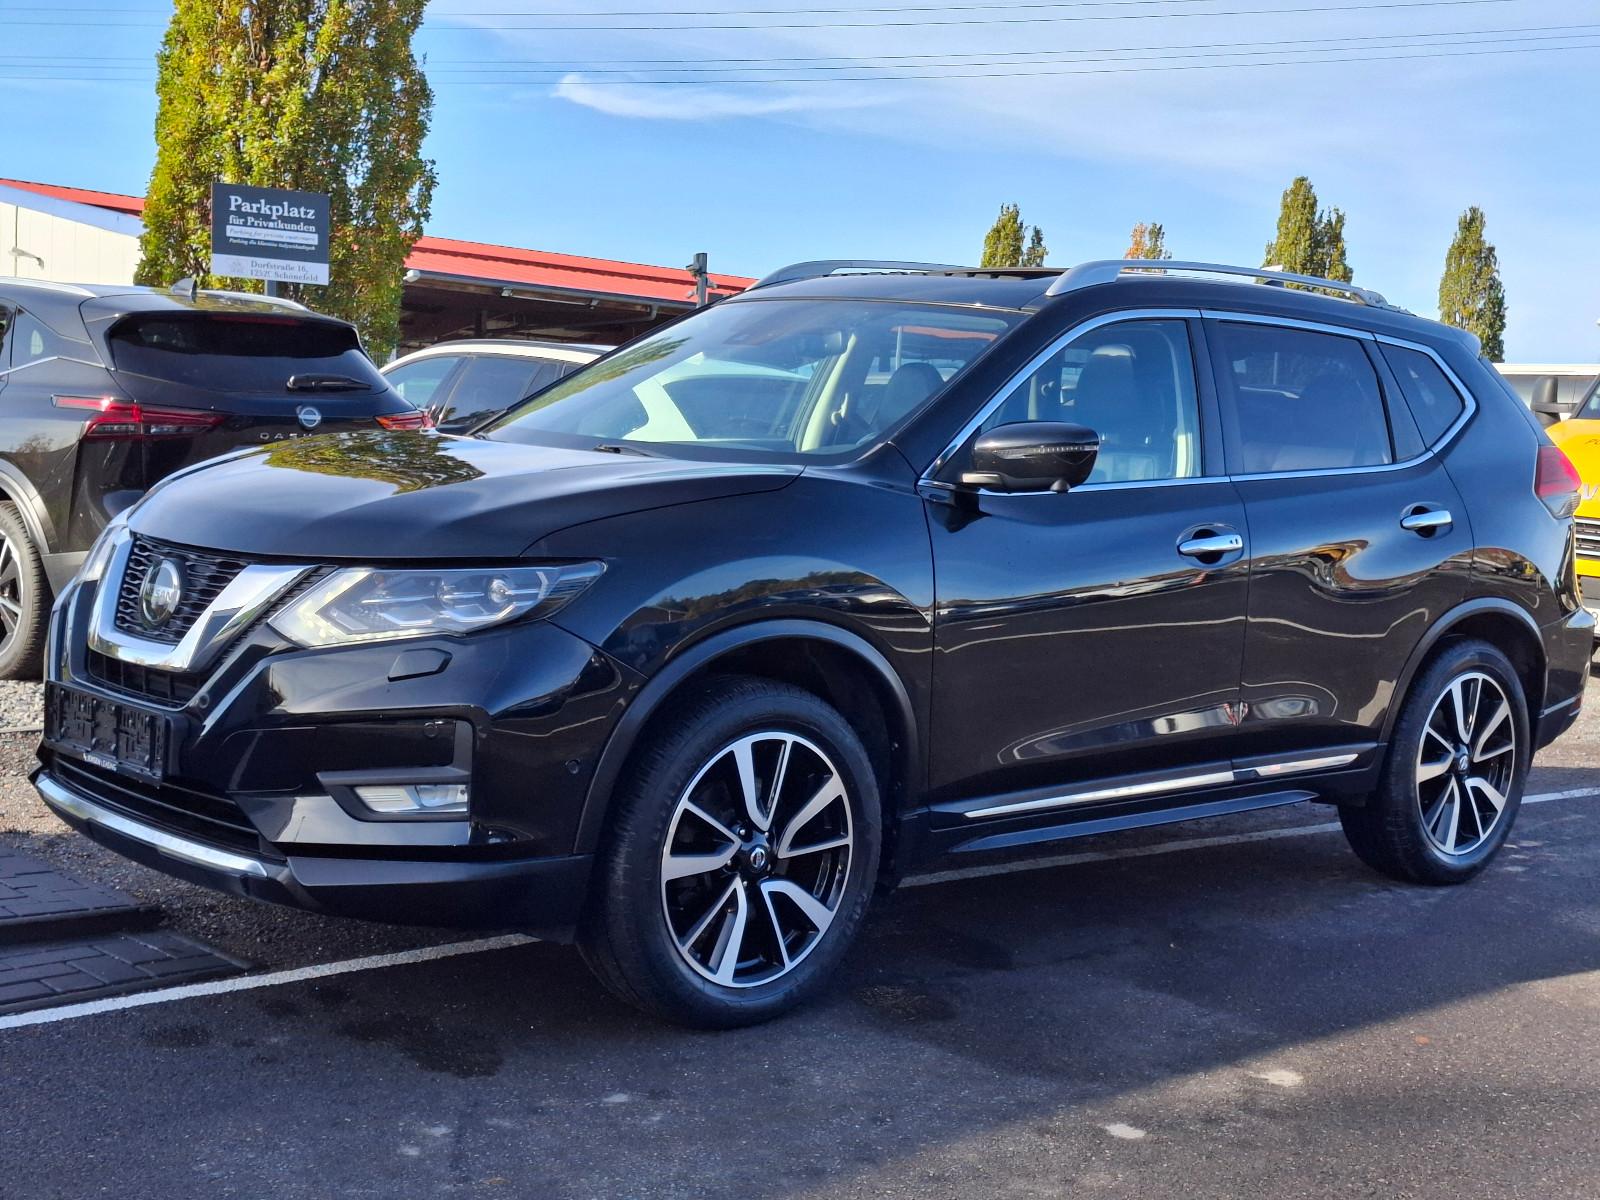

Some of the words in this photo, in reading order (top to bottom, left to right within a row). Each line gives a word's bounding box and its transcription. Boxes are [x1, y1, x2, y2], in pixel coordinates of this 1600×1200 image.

[229, 195, 316, 219] Parkplatz
[229, 215, 245, 225] für
[247, 217, 316, 232] Privatkunden
